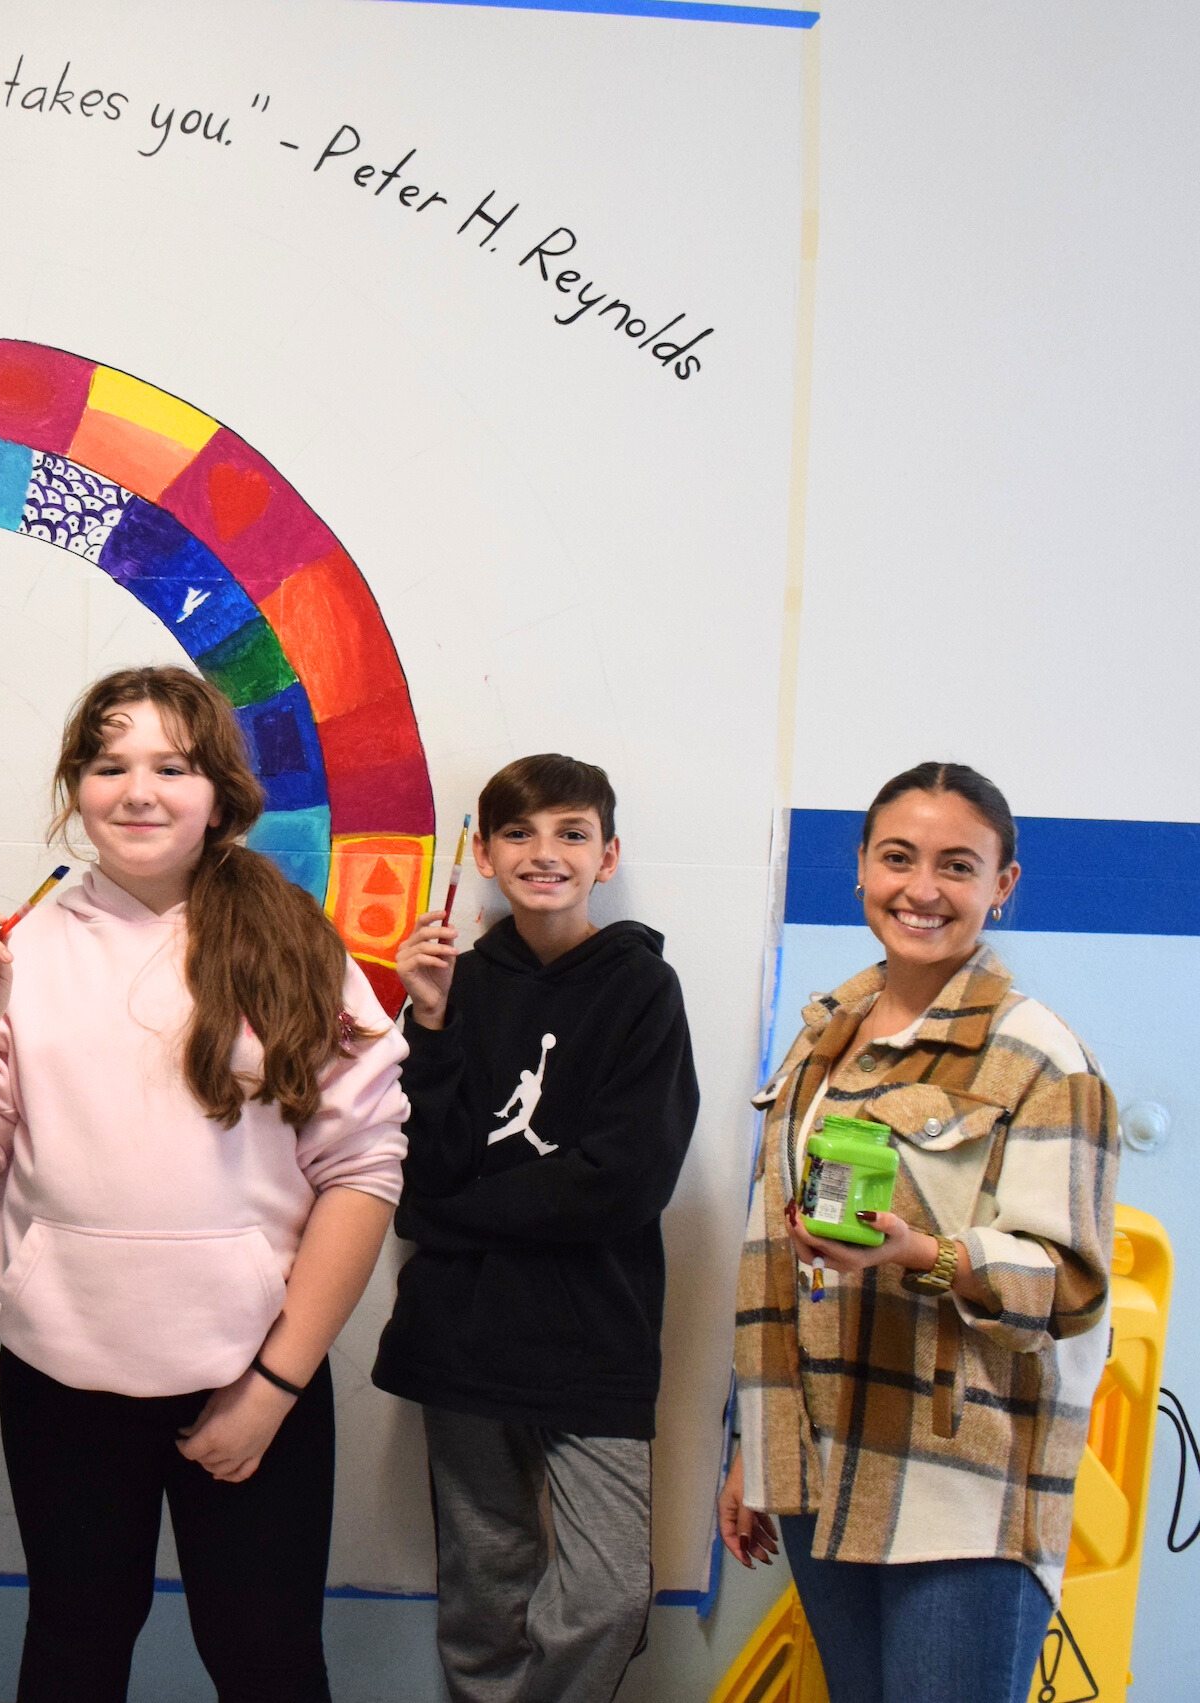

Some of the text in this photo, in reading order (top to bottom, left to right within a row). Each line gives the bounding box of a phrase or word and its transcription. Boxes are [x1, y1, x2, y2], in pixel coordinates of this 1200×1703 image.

[3, 54, 130, 121] takes
[312, 124, 448, 213] Peter
[456, 189, 520, 253] H.
[518, 226, 715, 381] Reynolds
